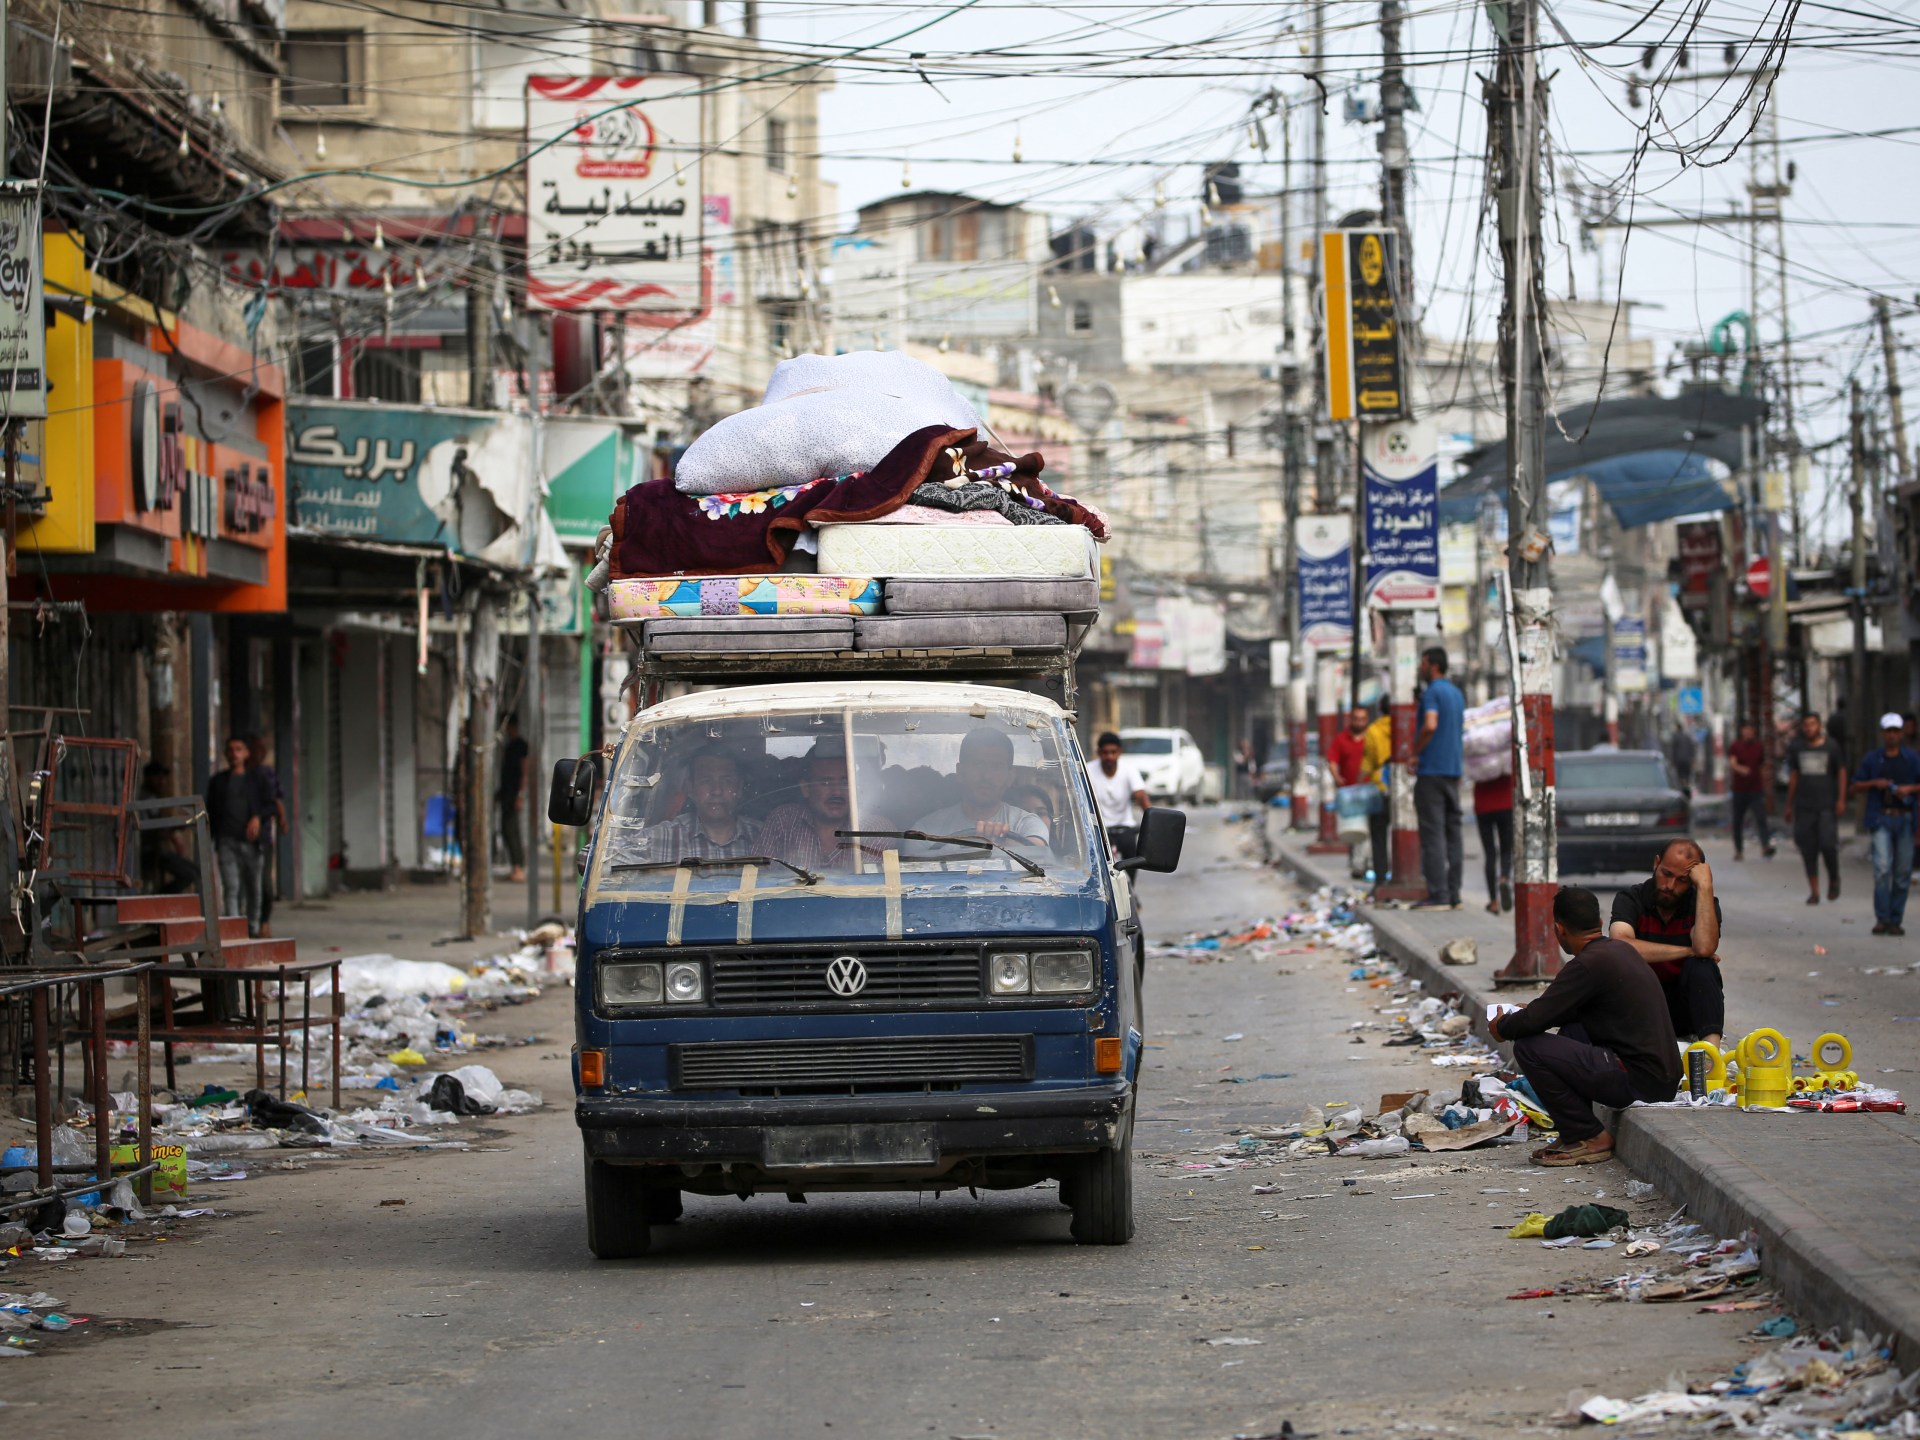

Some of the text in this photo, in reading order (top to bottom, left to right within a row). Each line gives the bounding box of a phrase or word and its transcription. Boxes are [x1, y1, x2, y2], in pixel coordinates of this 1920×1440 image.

[543, 181, 686, 227] صيدلية
[546, 231, 683, 271] العودة
[1372, 507, 1433, 536] العودة
